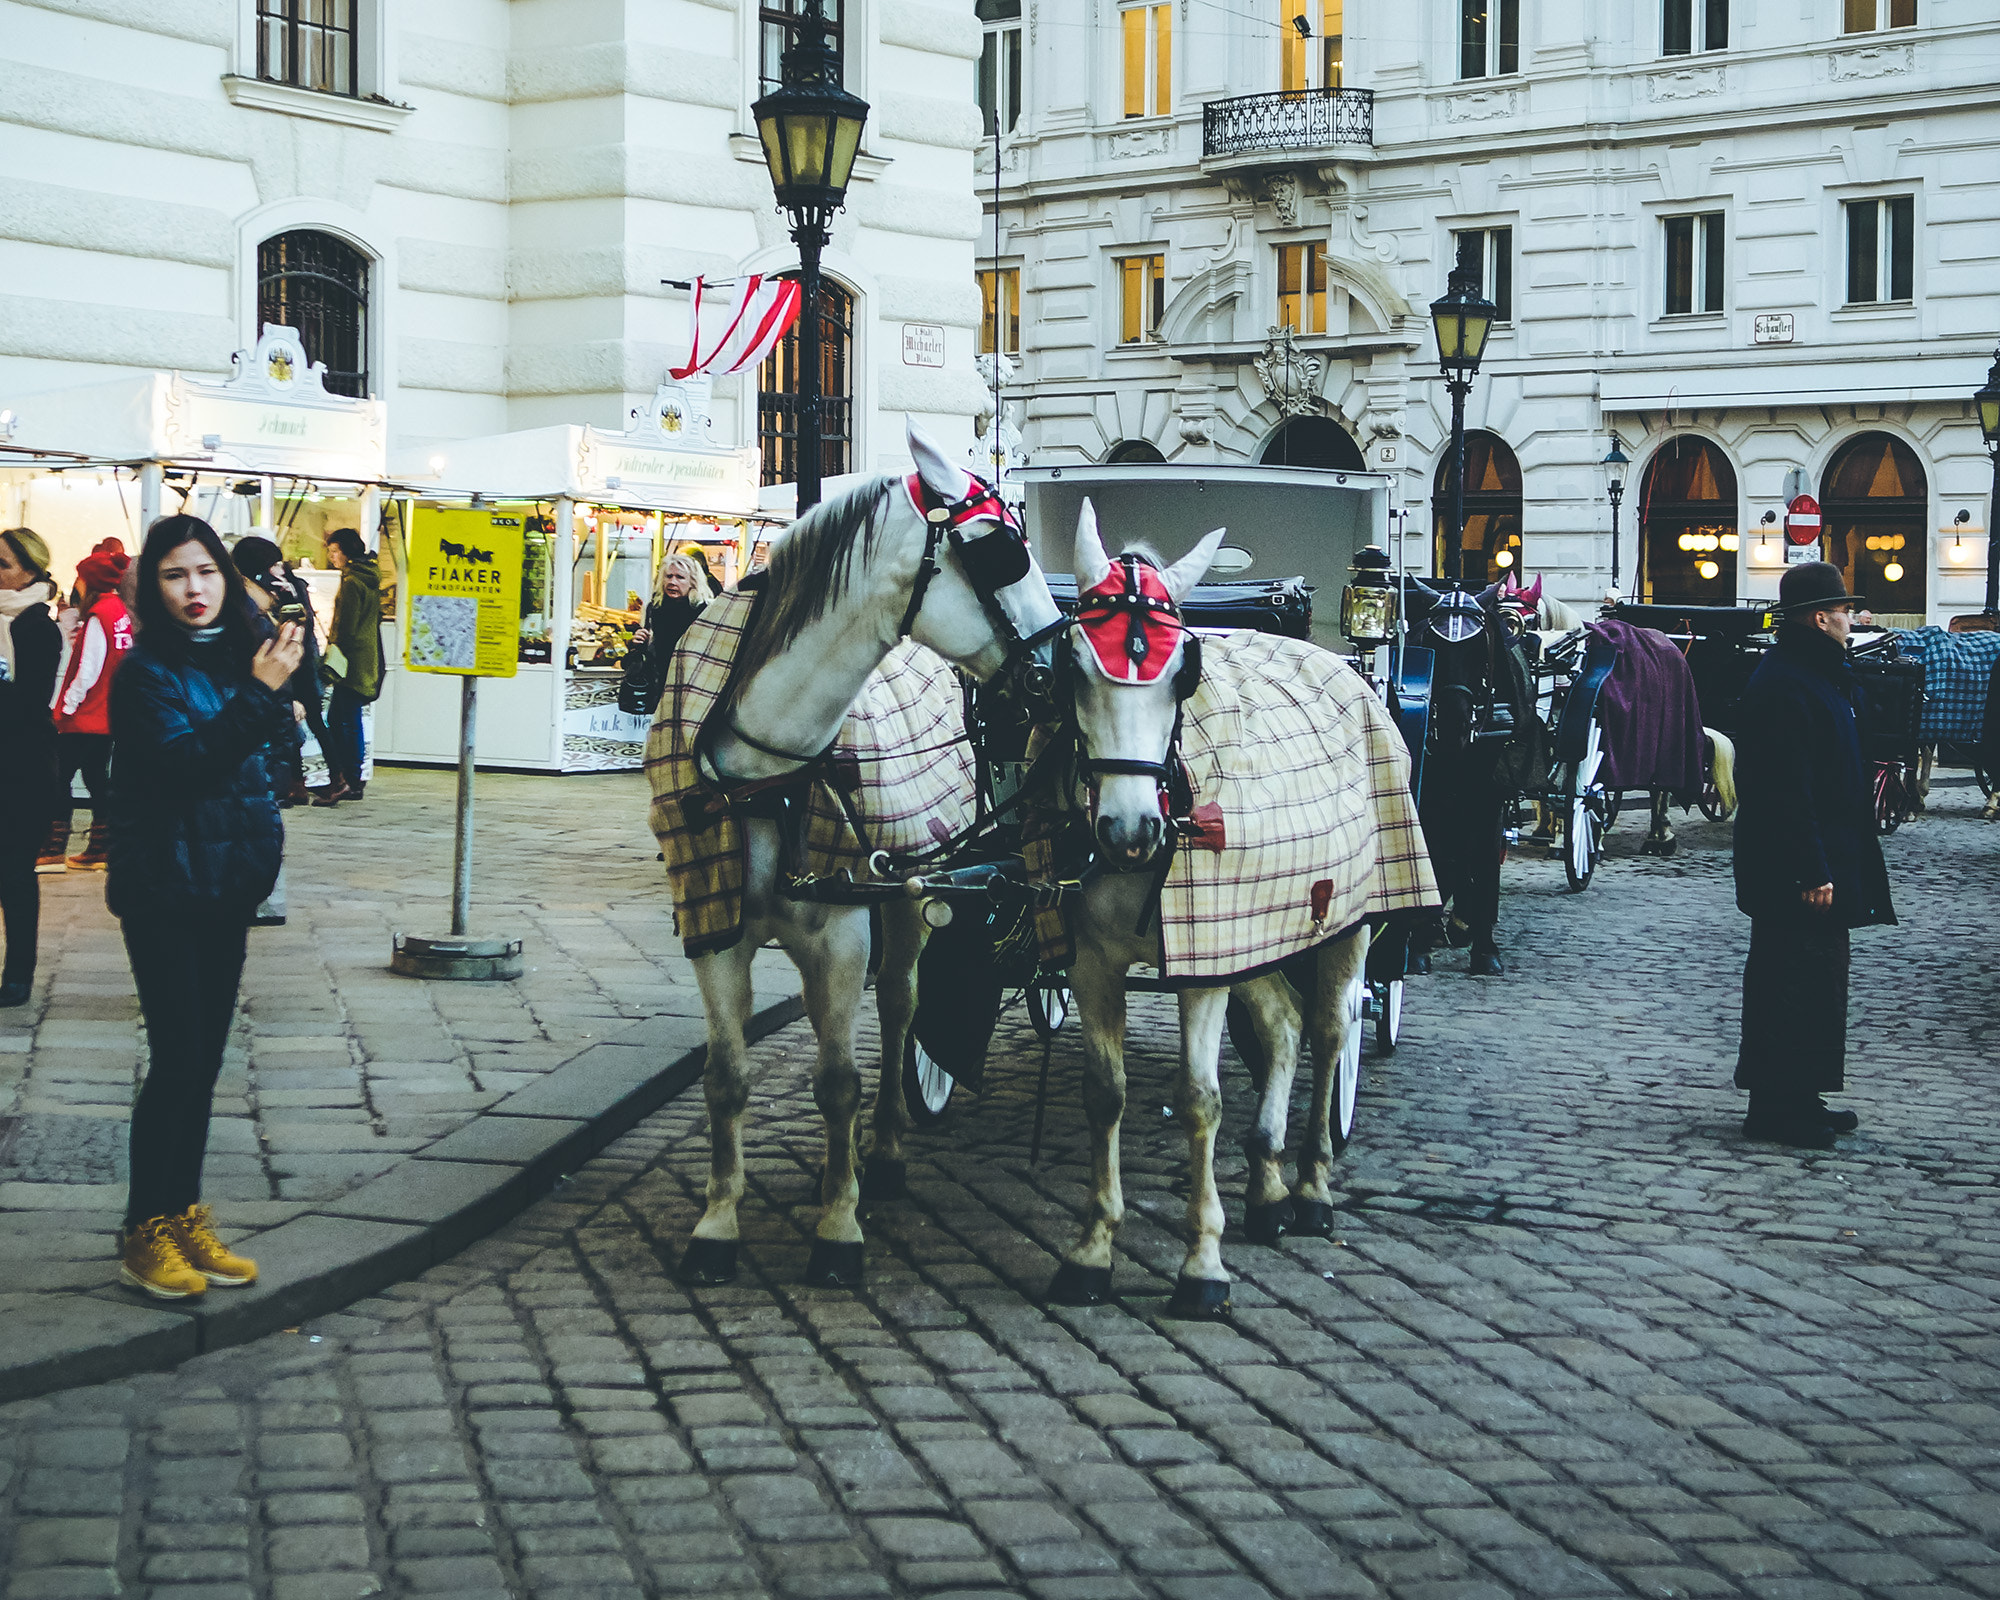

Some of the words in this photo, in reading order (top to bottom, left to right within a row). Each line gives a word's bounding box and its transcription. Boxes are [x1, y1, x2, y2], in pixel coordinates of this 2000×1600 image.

[905, 335, 942, 353] Michaeler
[1385, 449, 1391, 458] 2
[429, 567, 501, 584] FIAKER
[428, 583, 501, 594] RUNDFAHRTEN
